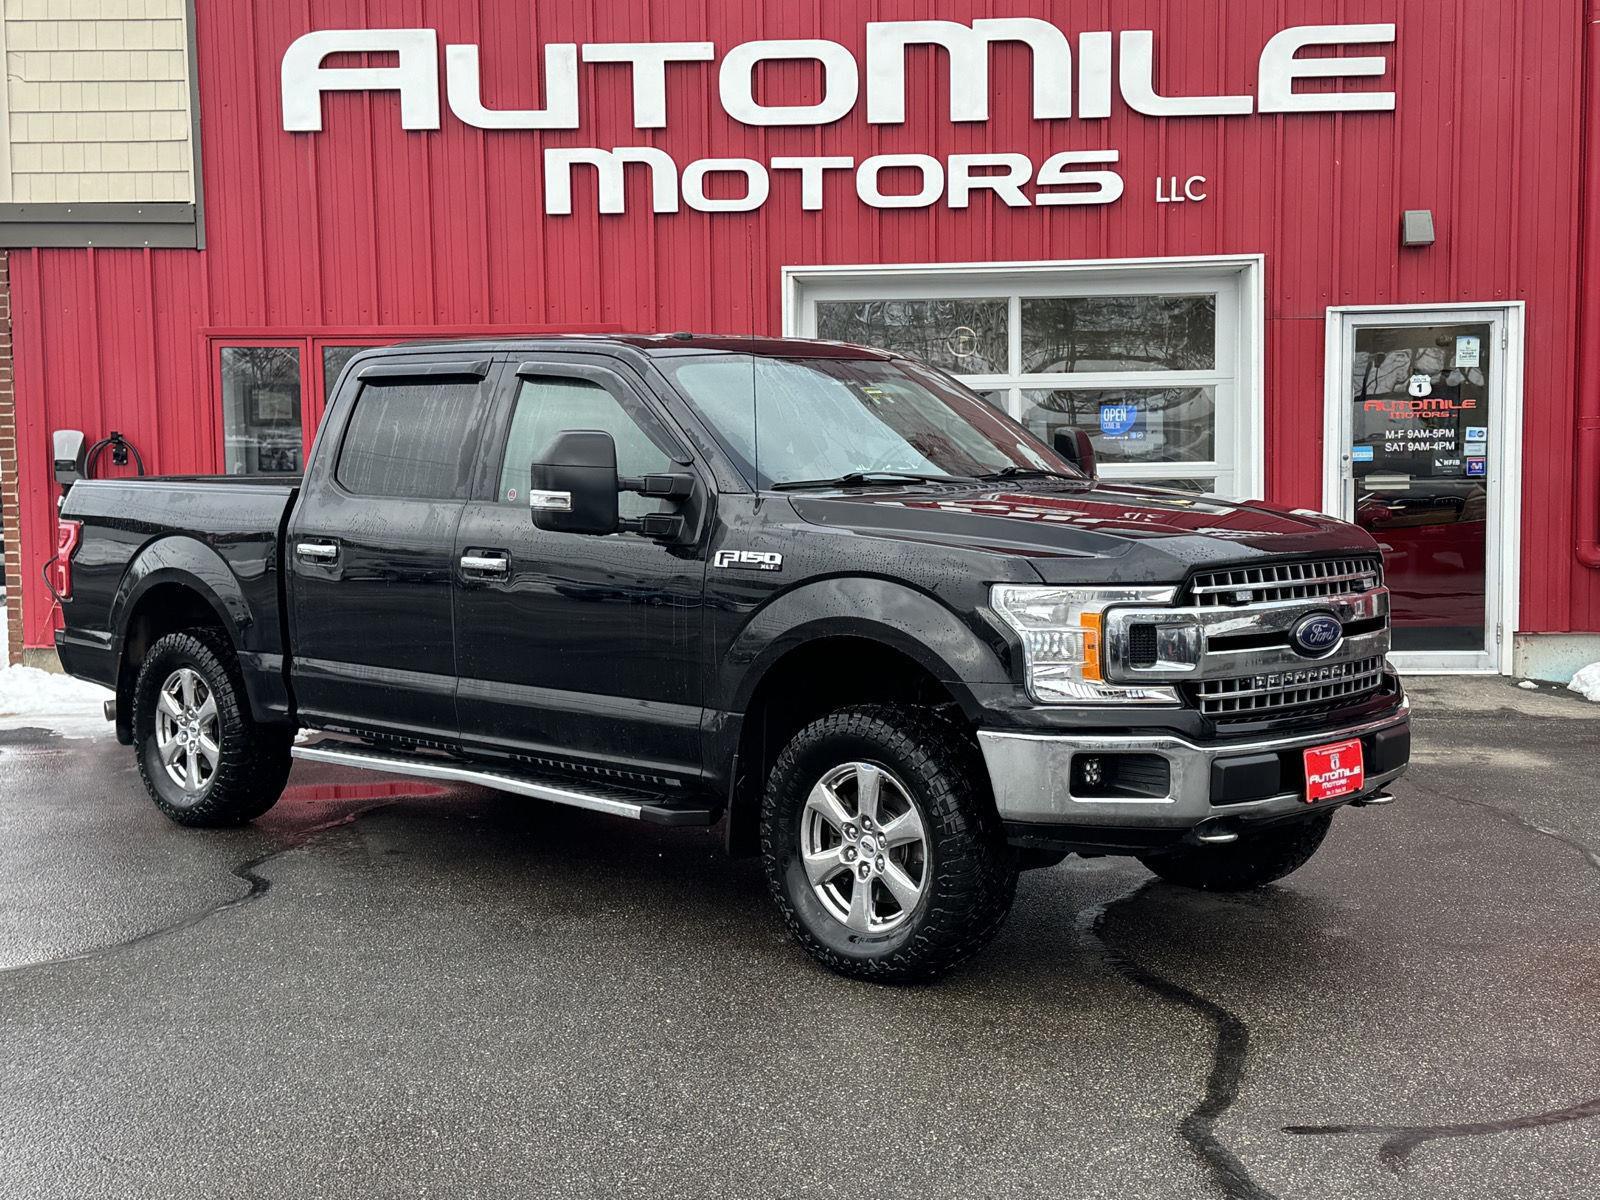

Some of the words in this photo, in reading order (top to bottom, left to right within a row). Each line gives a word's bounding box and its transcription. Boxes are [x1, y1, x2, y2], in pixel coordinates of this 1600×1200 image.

[1156, 175, 1207, 203] LLC
[1417, 383, 1422, 393] 1
[1103, 408, 1127, 421] OPEN
[1385, 430, 1405, 439] M-F
[1407, 428, 1455, 439] 9AM-5PM
[1385, 442, 1405, 452] SAT
[1407, 441, 1455, 452] 9AM-4PM
[1310, 623, 1335, 643] Ford
